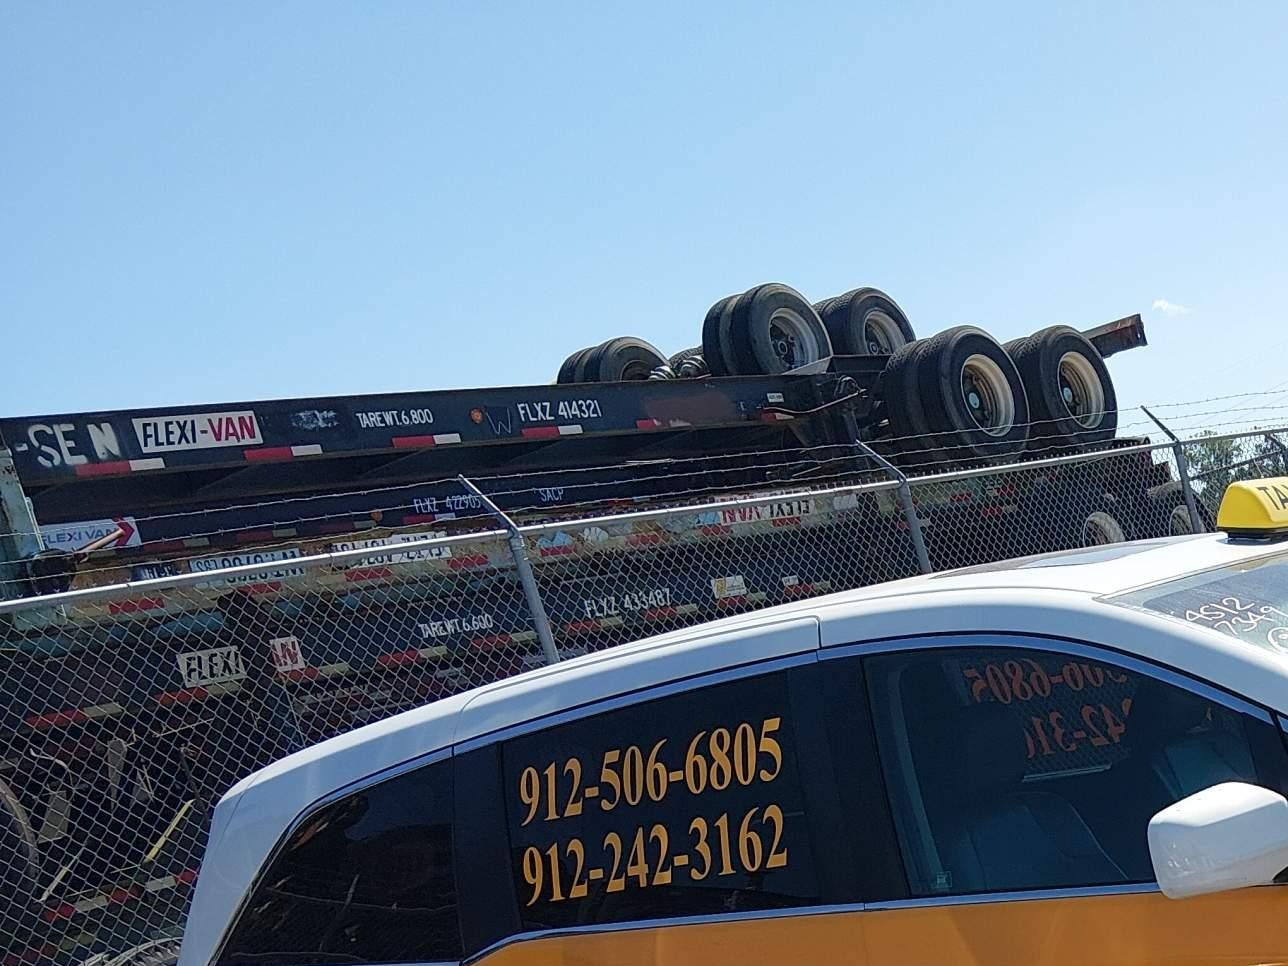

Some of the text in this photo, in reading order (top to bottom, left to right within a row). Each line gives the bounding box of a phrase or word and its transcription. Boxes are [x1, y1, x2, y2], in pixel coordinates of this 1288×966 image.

[517, 400, 602, 421] FLXZ 414321
[142, 415, 257, 448] FLEXI-VAN
[584, 596, 619, 618] FLXZ
[1186, 597, 1255, 622] 4512
[520, 717, 782, 827] 912-506-6805
[523, 804, 787, 907] 912-242-3162
